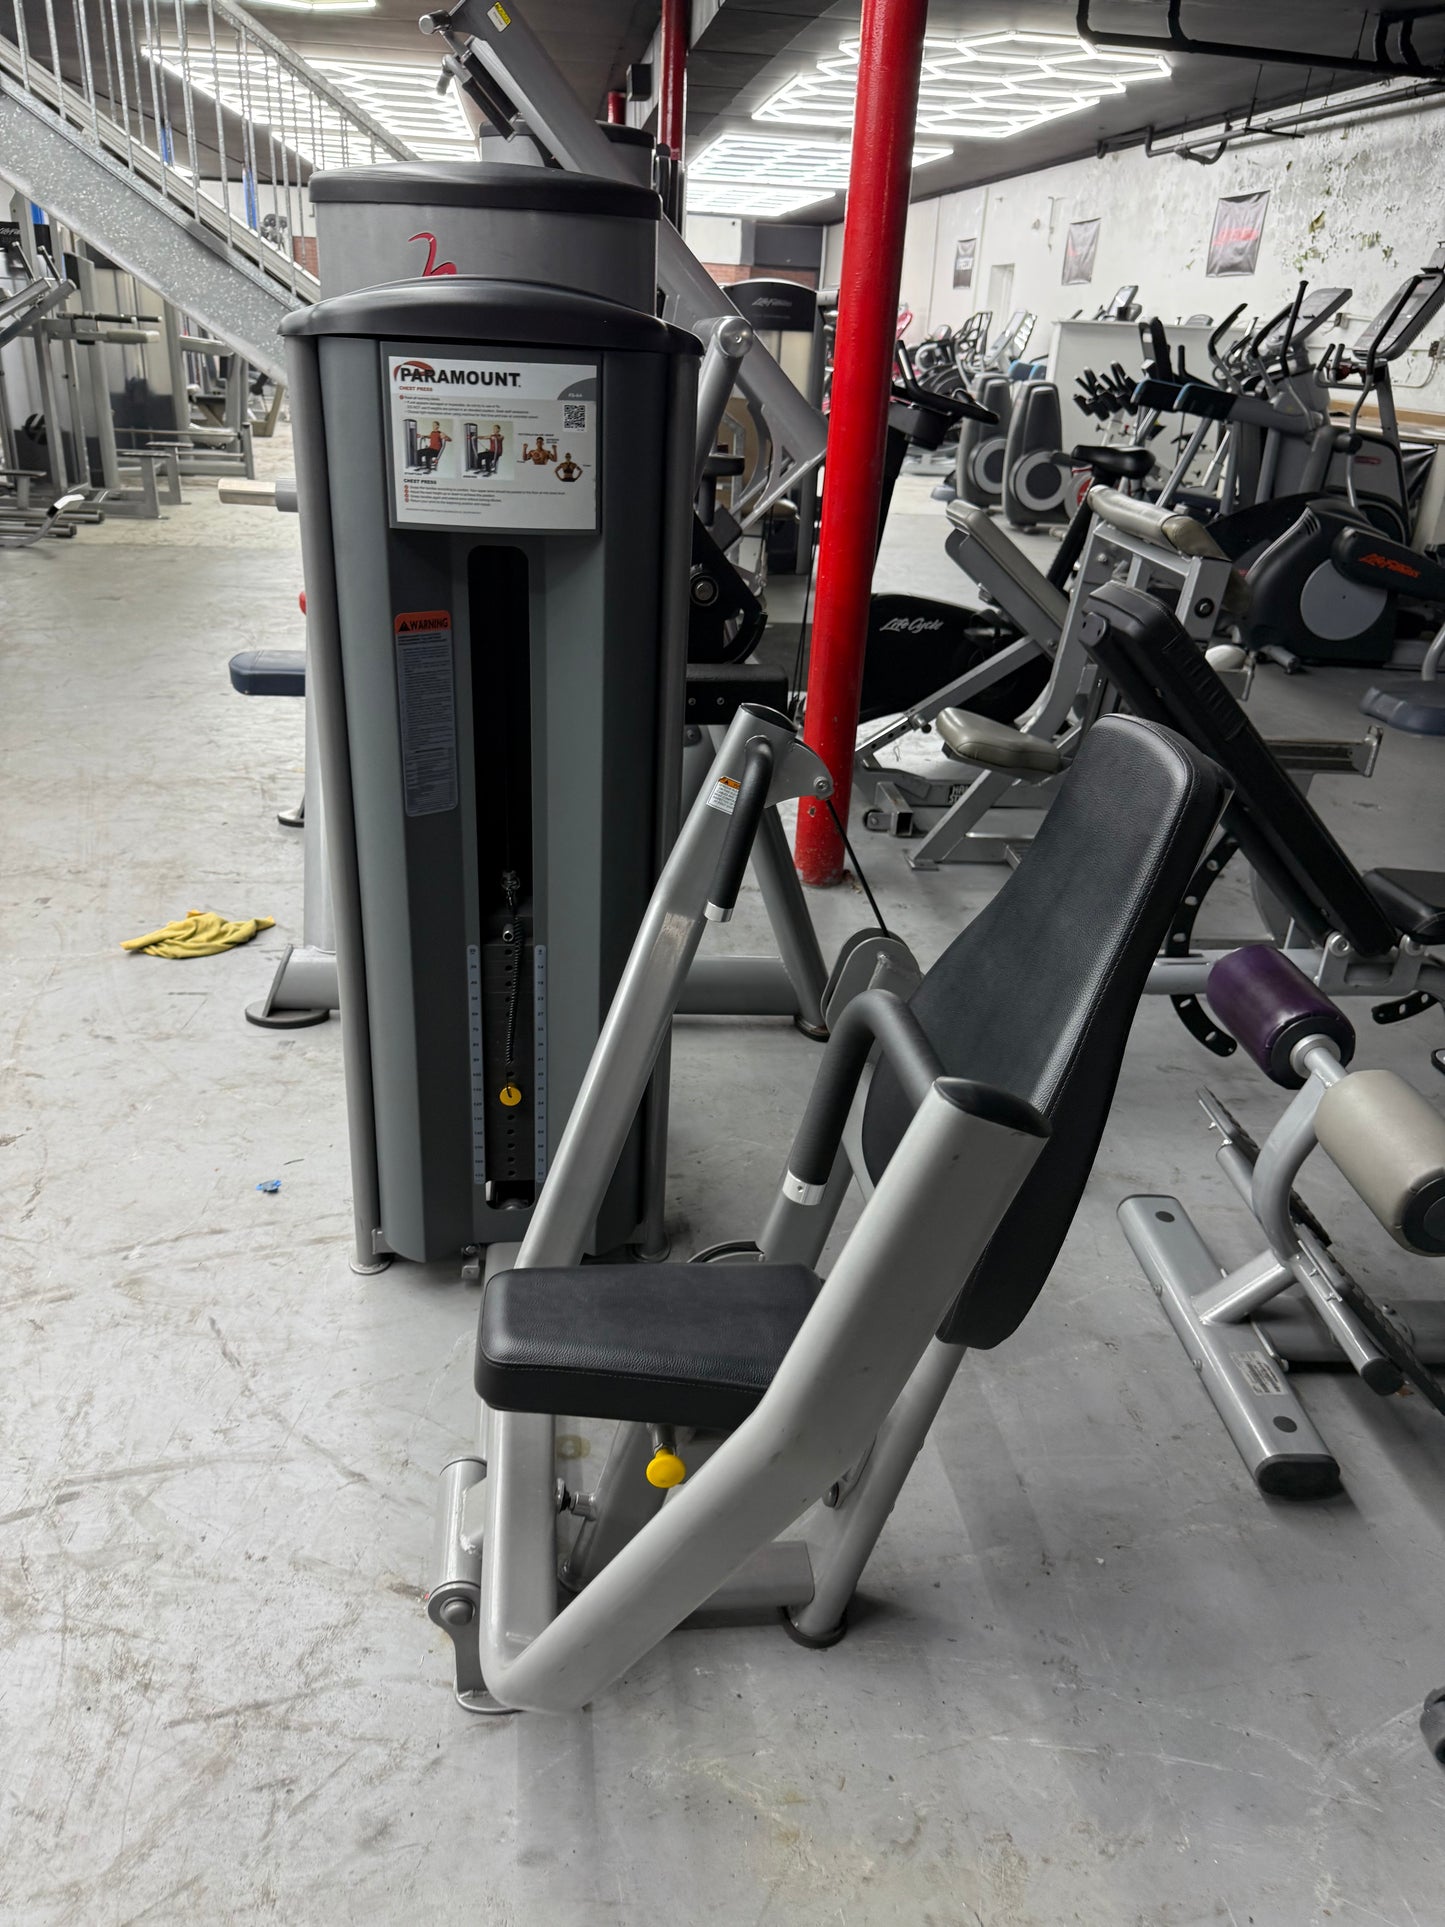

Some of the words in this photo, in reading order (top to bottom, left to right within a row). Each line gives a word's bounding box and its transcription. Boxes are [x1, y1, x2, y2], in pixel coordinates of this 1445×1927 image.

[401, 367, 520, 387] PARAMOUNT
[410, 618, 448, 631] WARNING
[879, 617, 909, 632] Life
[908, 617, 944, 634] Cycle
